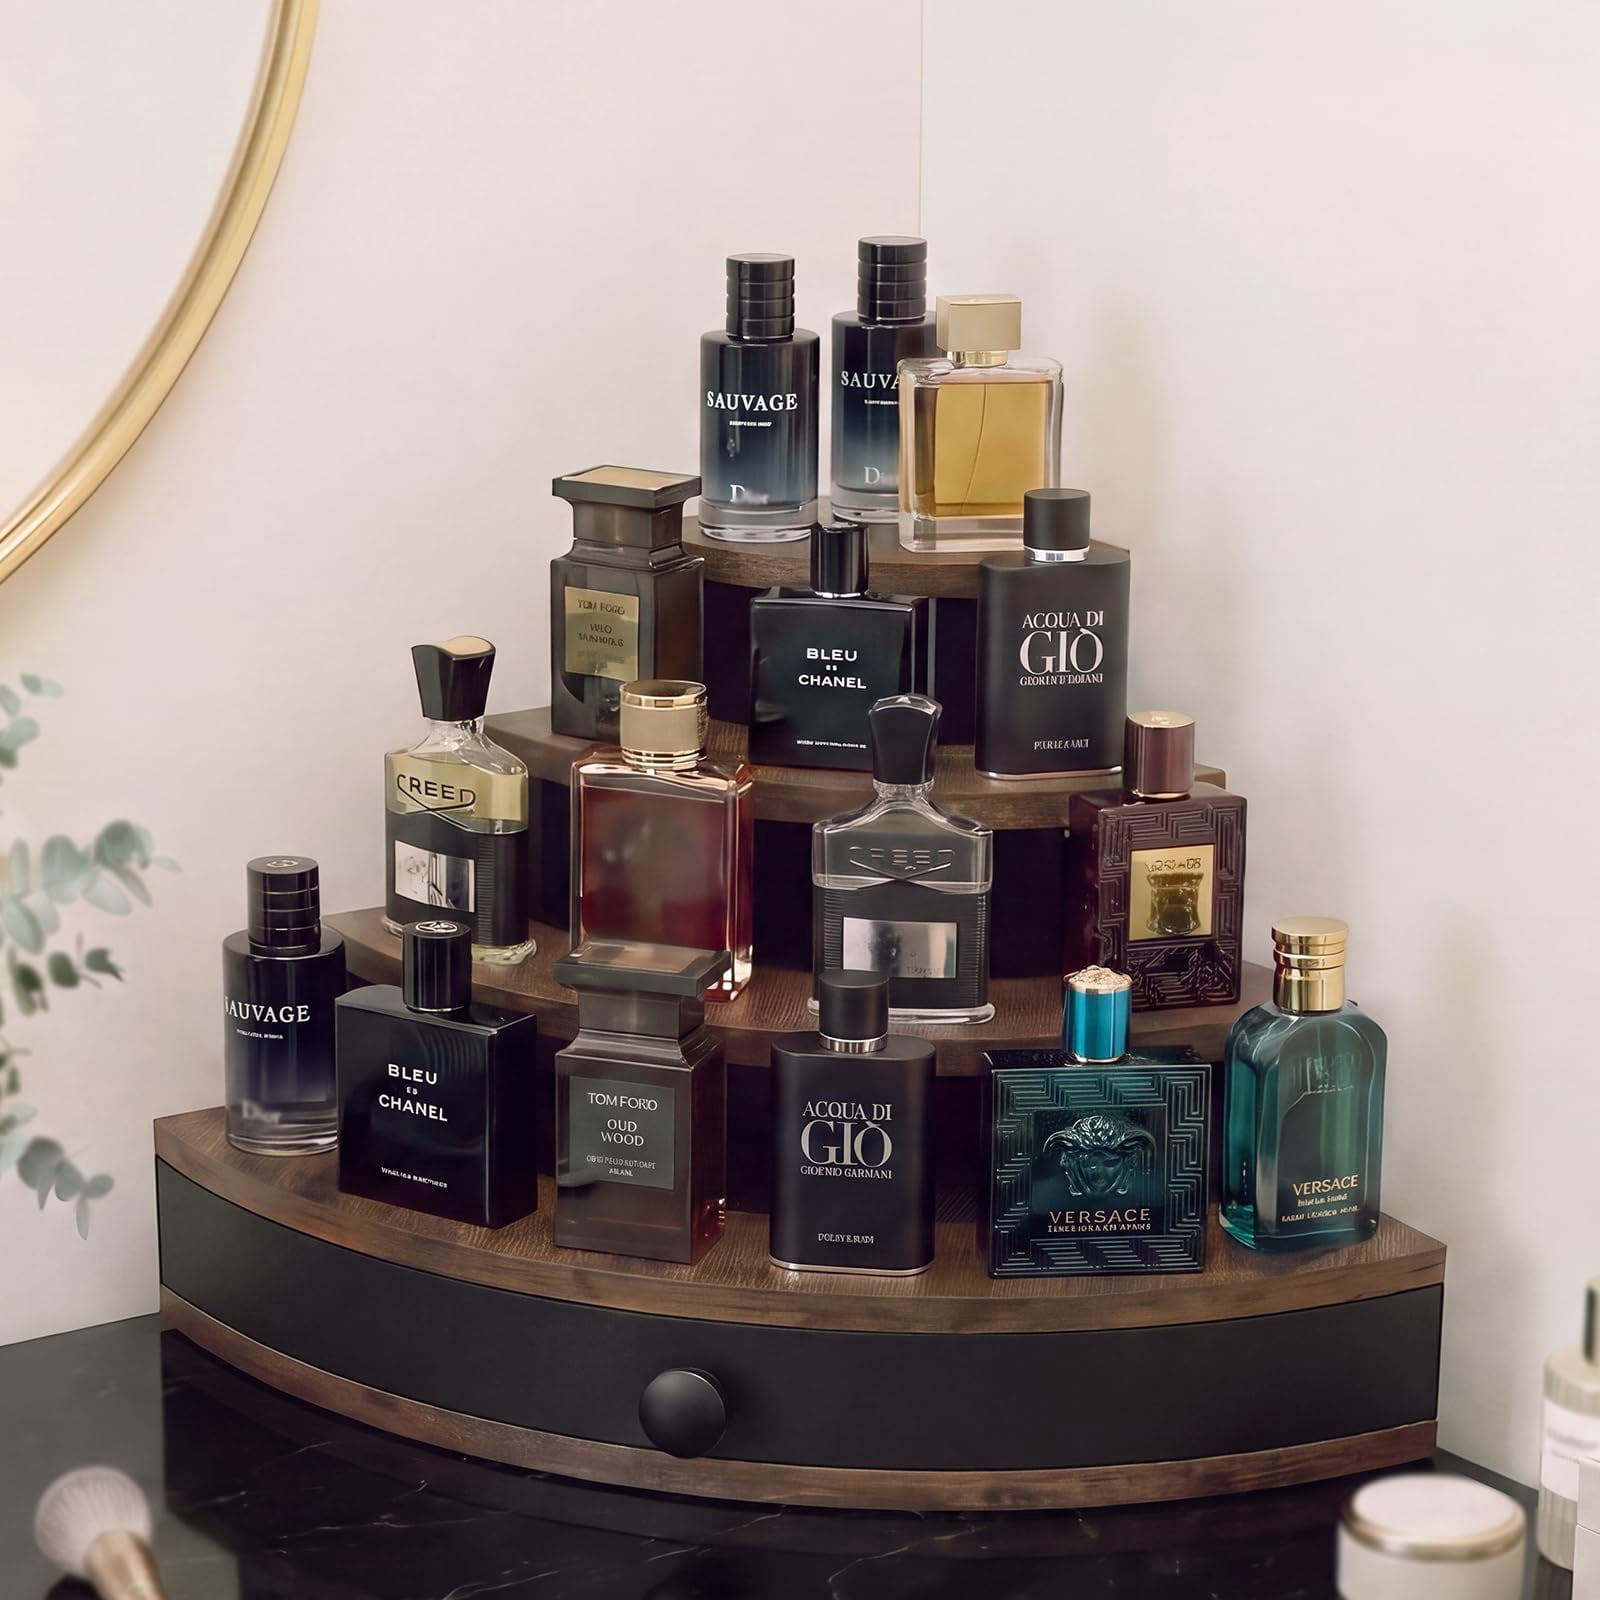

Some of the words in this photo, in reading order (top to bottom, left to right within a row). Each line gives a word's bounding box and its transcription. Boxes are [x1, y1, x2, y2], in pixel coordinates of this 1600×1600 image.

[706, 390, 798, 412] SAUVAGE
[1022, 611, 1081, 629] ACQUA
[1086, 610, 1104, 627] DI
[806, 647, 858, 662] BLEU
[798, 674, 867, 689] CHANEL
[397, 774, 477, 809] CREED
[388, 1063, 437, 1085] BLEU
[378, 1094, 448, 1122] CHANEL
[587, 1092, 618, 1106] TOM
[802, 1100, 868, 1120] ACQUA
[872, 1103, 893, 1121] DI
[607, 1118, 637, 1133] OUD
[600, 1131, 644, 1146] WOOD
[1293, 1174, 1359, 1196] VERSACE
[1049, 1208, 1151, 1224] VERSACE
